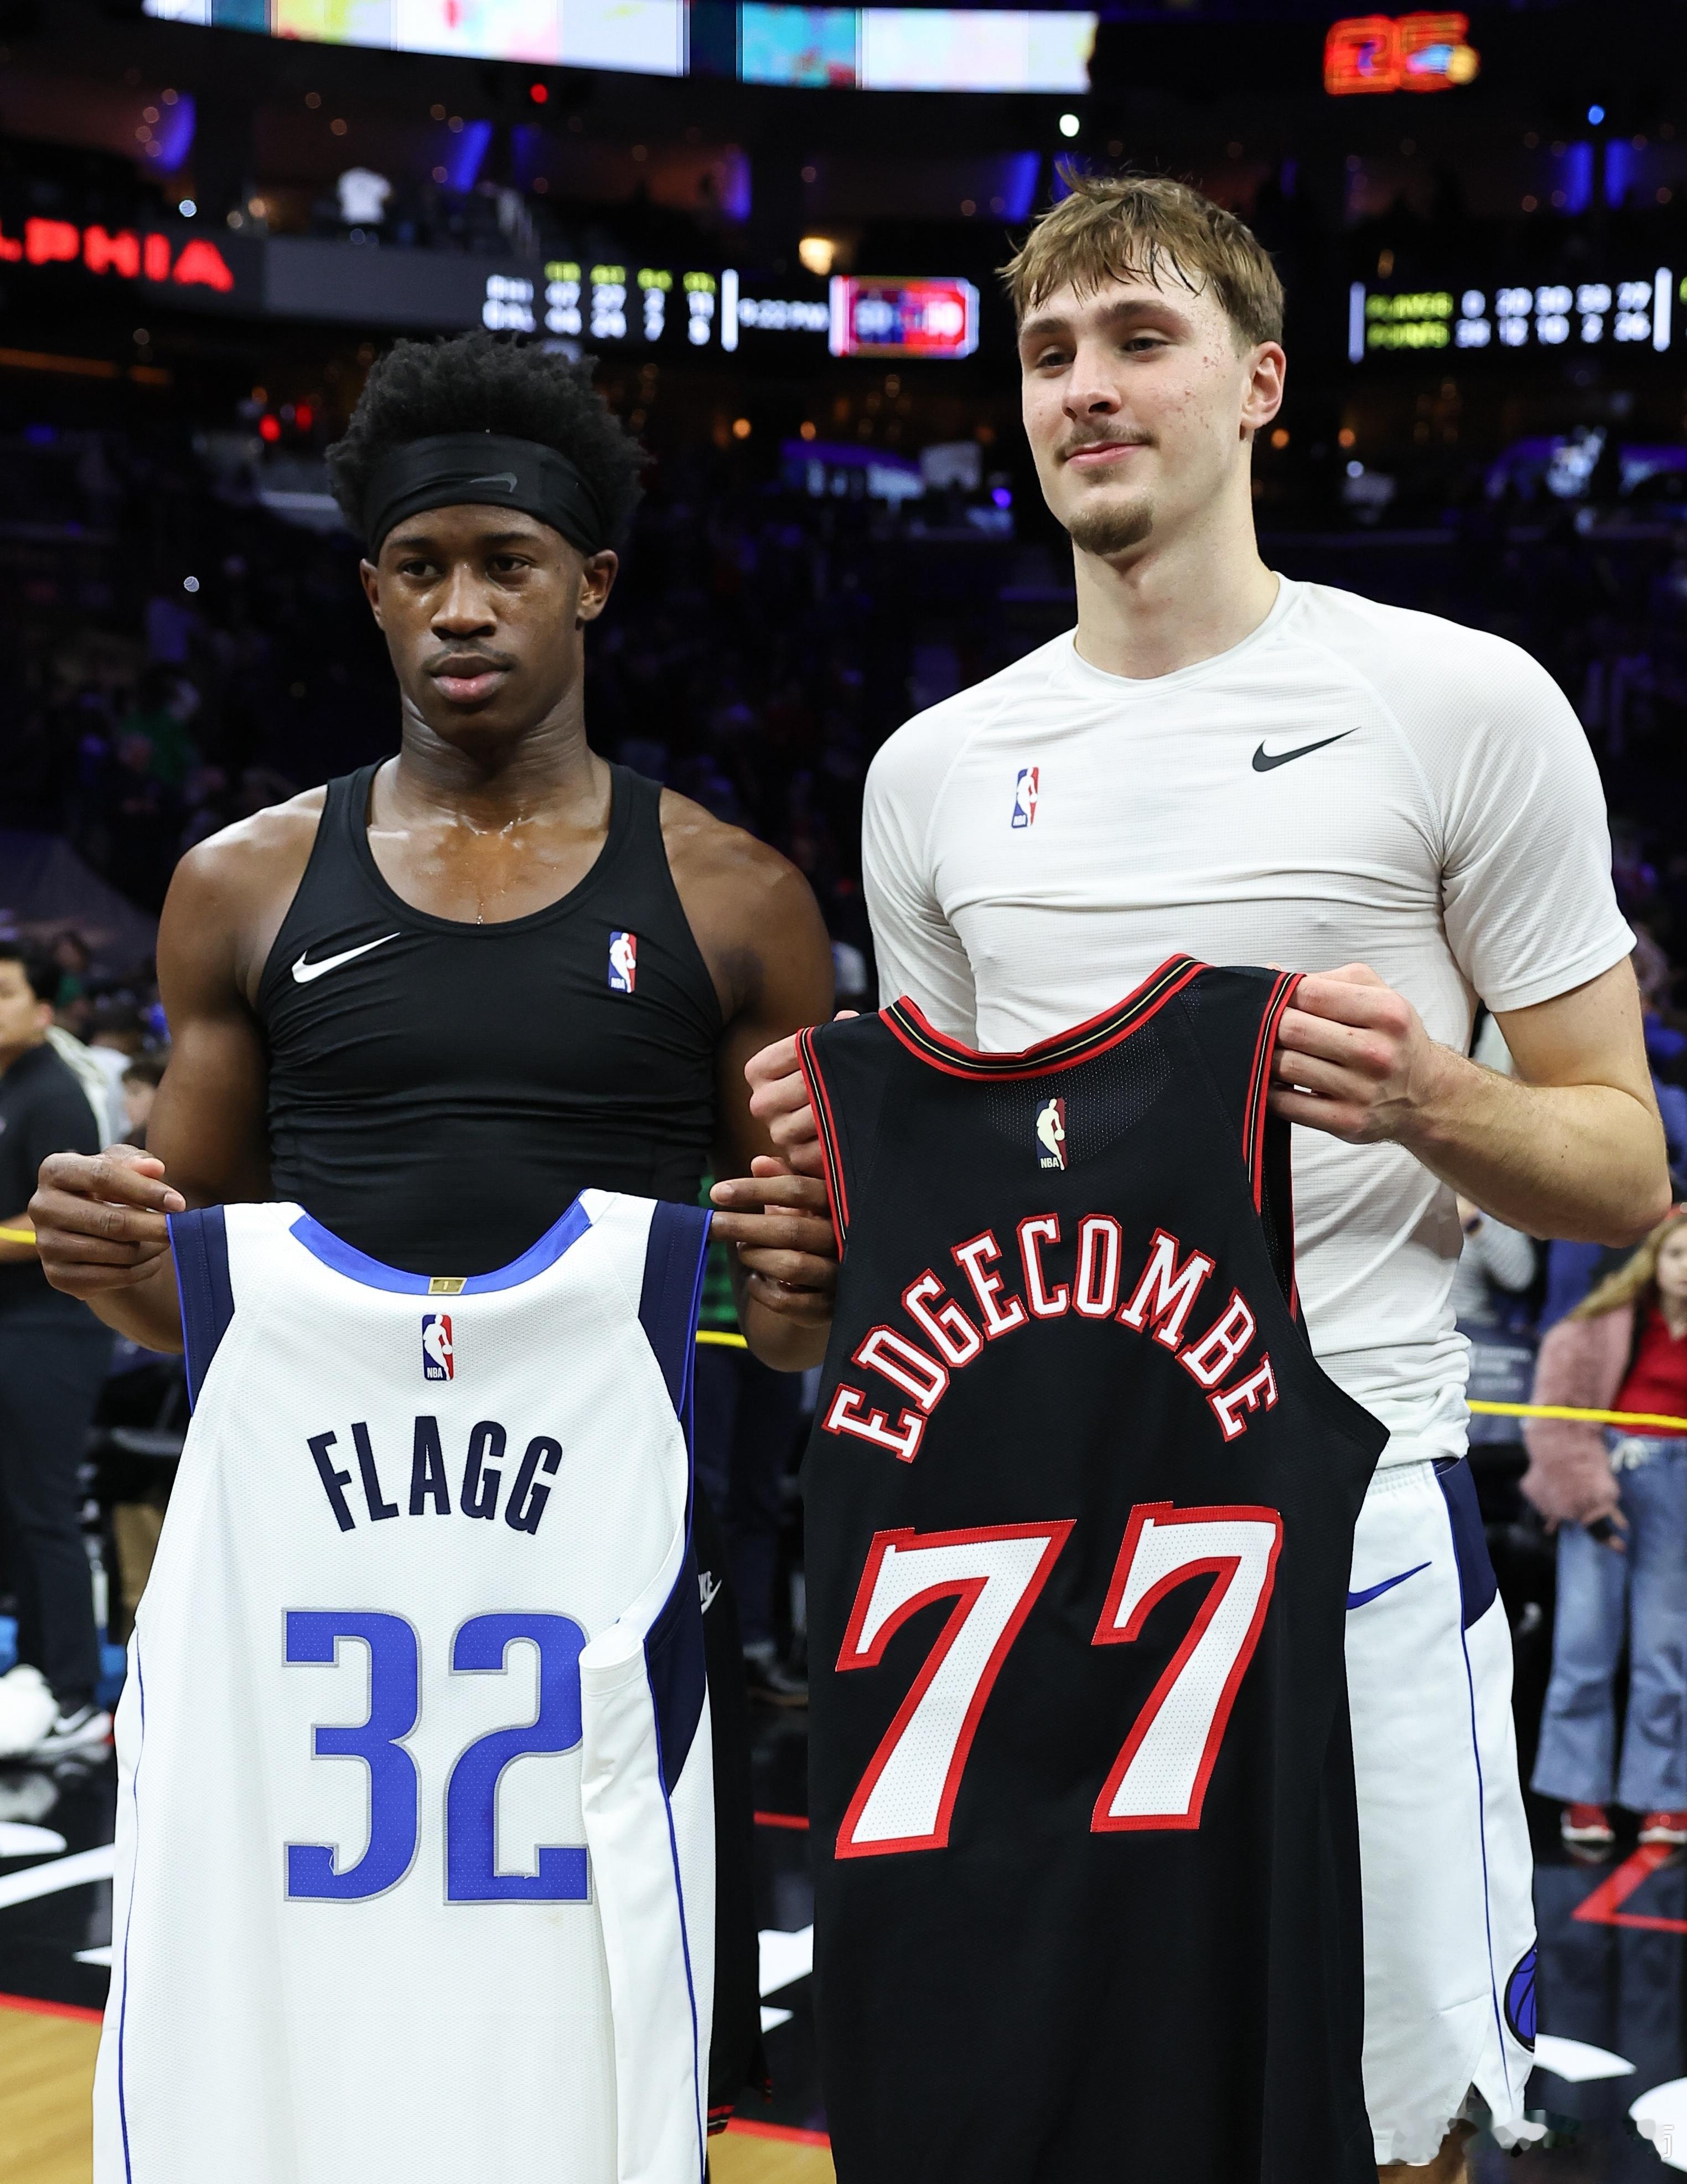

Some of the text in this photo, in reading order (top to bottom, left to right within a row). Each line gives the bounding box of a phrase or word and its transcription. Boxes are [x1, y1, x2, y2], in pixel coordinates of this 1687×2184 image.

[1040, 1157, 1059, 1169] NBA
[427, 1367, 443, 1378] NBA
[821, 1213, 1279, 1463] EDGECOMBE
[307, 1416, 562, 1535] FLAGG
[281, 1607, 592, 1906] 32
[835, 1501, 1284, 1859] 77
